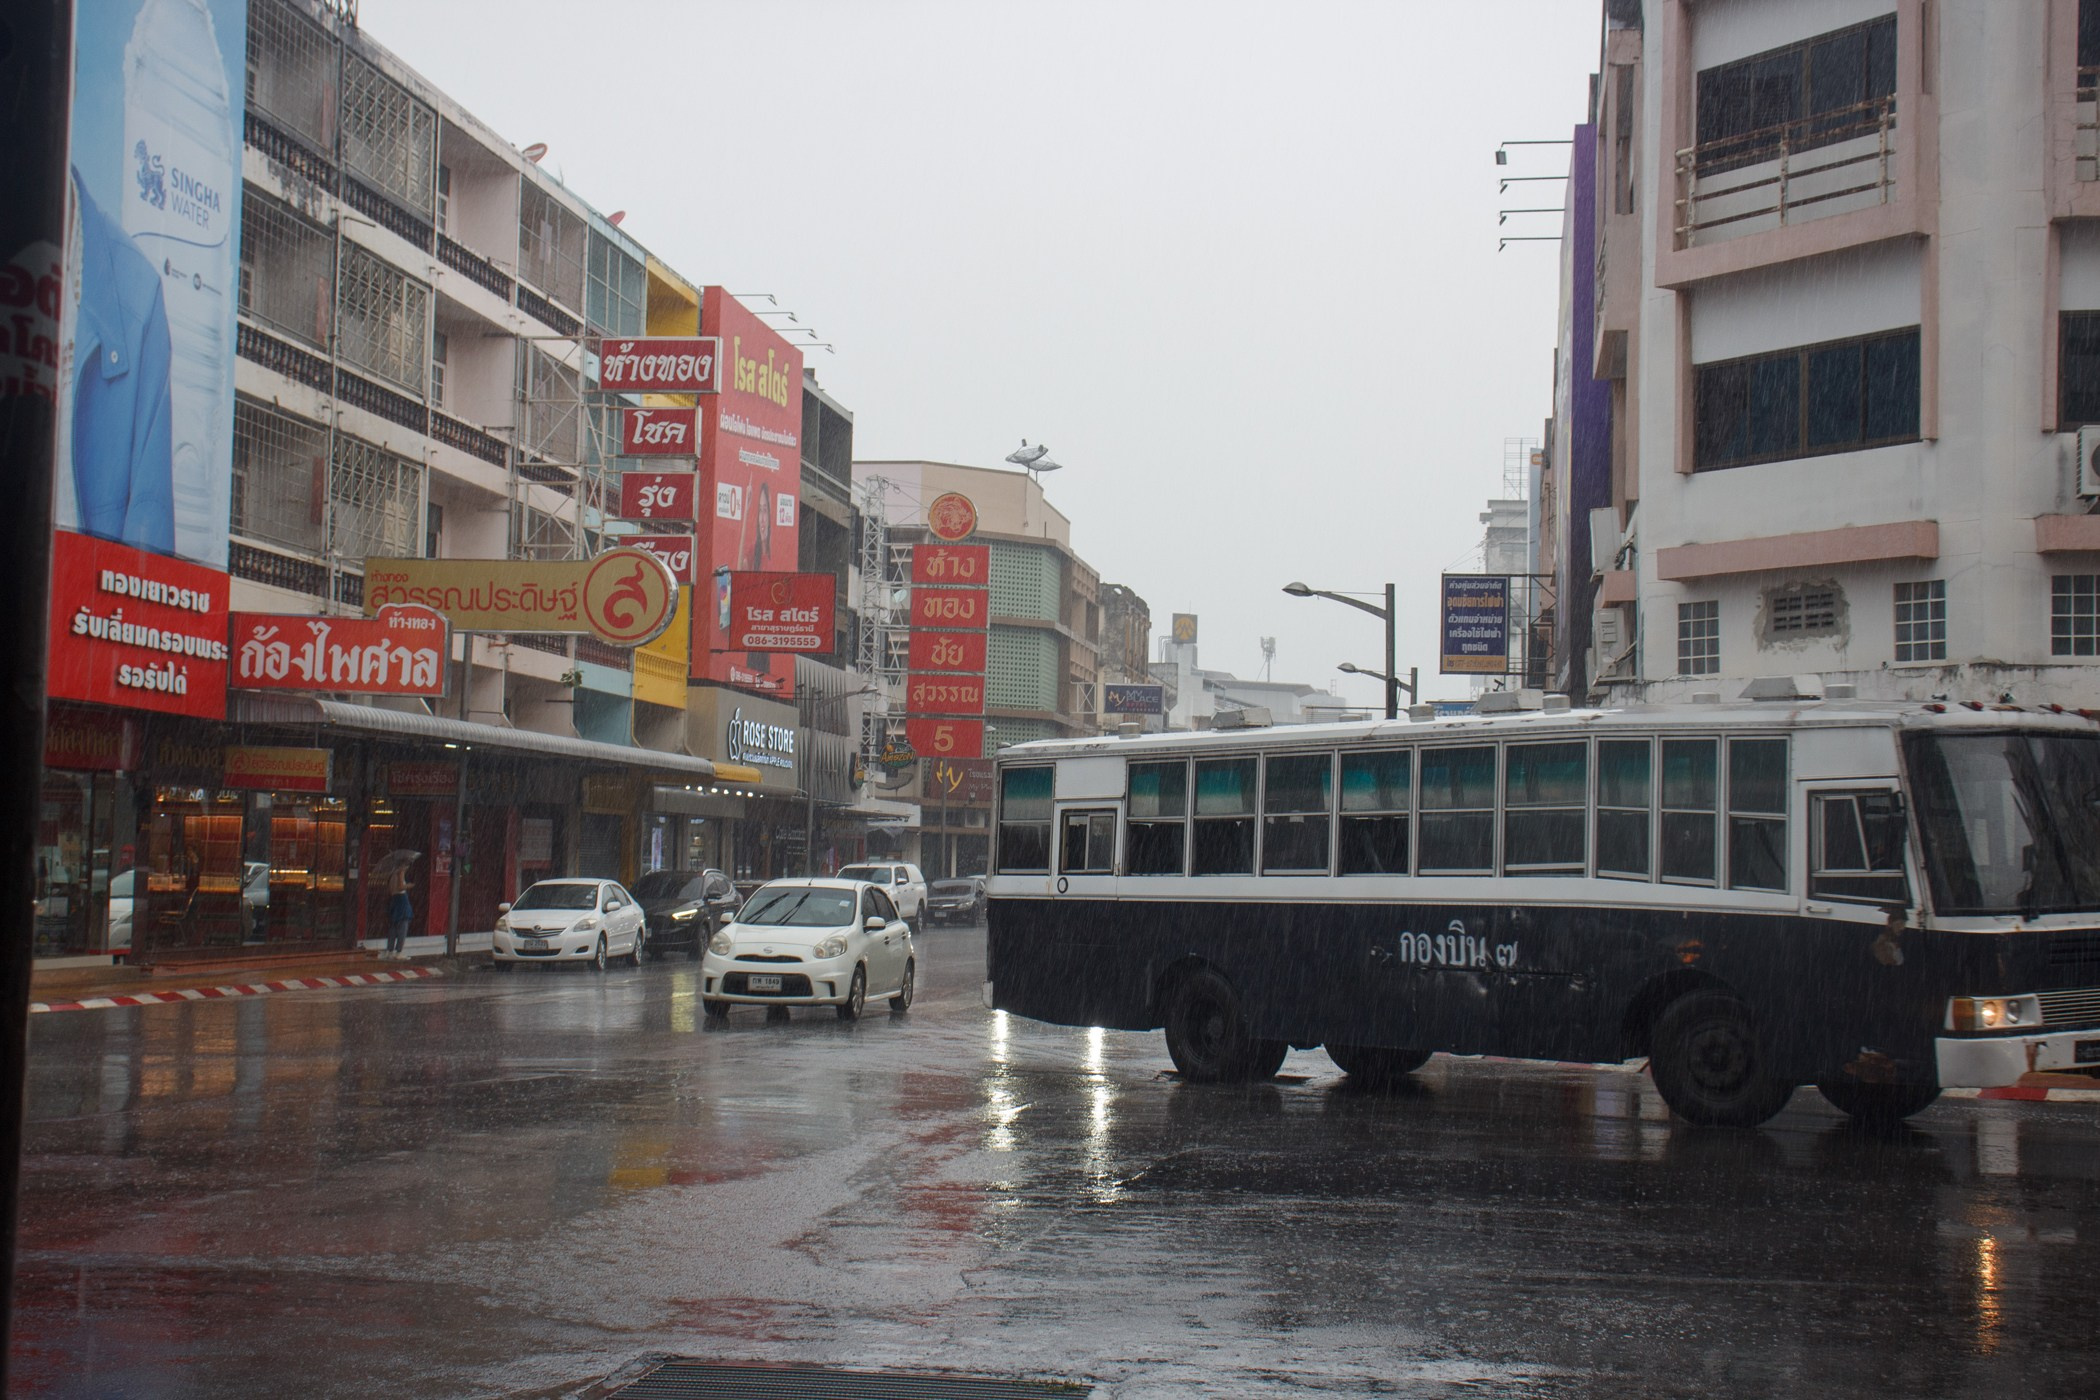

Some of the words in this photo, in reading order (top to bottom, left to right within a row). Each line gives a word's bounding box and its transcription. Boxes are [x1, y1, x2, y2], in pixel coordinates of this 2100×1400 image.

[171, 167, 220, 213] SINGHA
[171, 191, 209, 230] WATER
[604, 342, 713, 382] ห้างทอง
[734, 336, 756, 393] โรส
[759, 349, 790, 408] สโตร์
[632, 411, 687, 444] โชค
[638, 476, 677, 517] รุ่ง
[371, 570, 409, 584] ห้างทอง
[926, 549, 976, 578] ห้าง
[102, 569, 211, 614] ทองเยาวราช
[388, 611, 436, 631] ห้างทอง
[746, 606, 774, 622] โรส
[780, 606, 820, 623] สโตร์
[924, 597, 976, 620] ทอง
[1448, 613, 1503, 624] ตัวแทนจำหน่าย
[73, 606, 229, 661] รับเลี่ยมกรอบพระ
[747, 635, 816, 647] 086-3195555
[751, 624, 815, 634] สาขาสุราษฎร์ธานี
[1449, 626, 1502, 639] เครื่องใช้ไฟฟ้า
[240, 621, 439, 688] ก้องไพศาล
[931, 636, 964, 666] ชัย
[1461, 642, 1489, 654] ทุกชนิด
[118, 661, 188, 695] รอรับได้
[912, 682, 979, 708] สุวรรณ
[1126, 695, 1159, 703] PLACE
[743, 720, 766, 749] ROSE
[768, 725, 794, 753] STORE
[934, 724, 954, 752] 5
[1400, 920, 1486, 967] กองบิน
